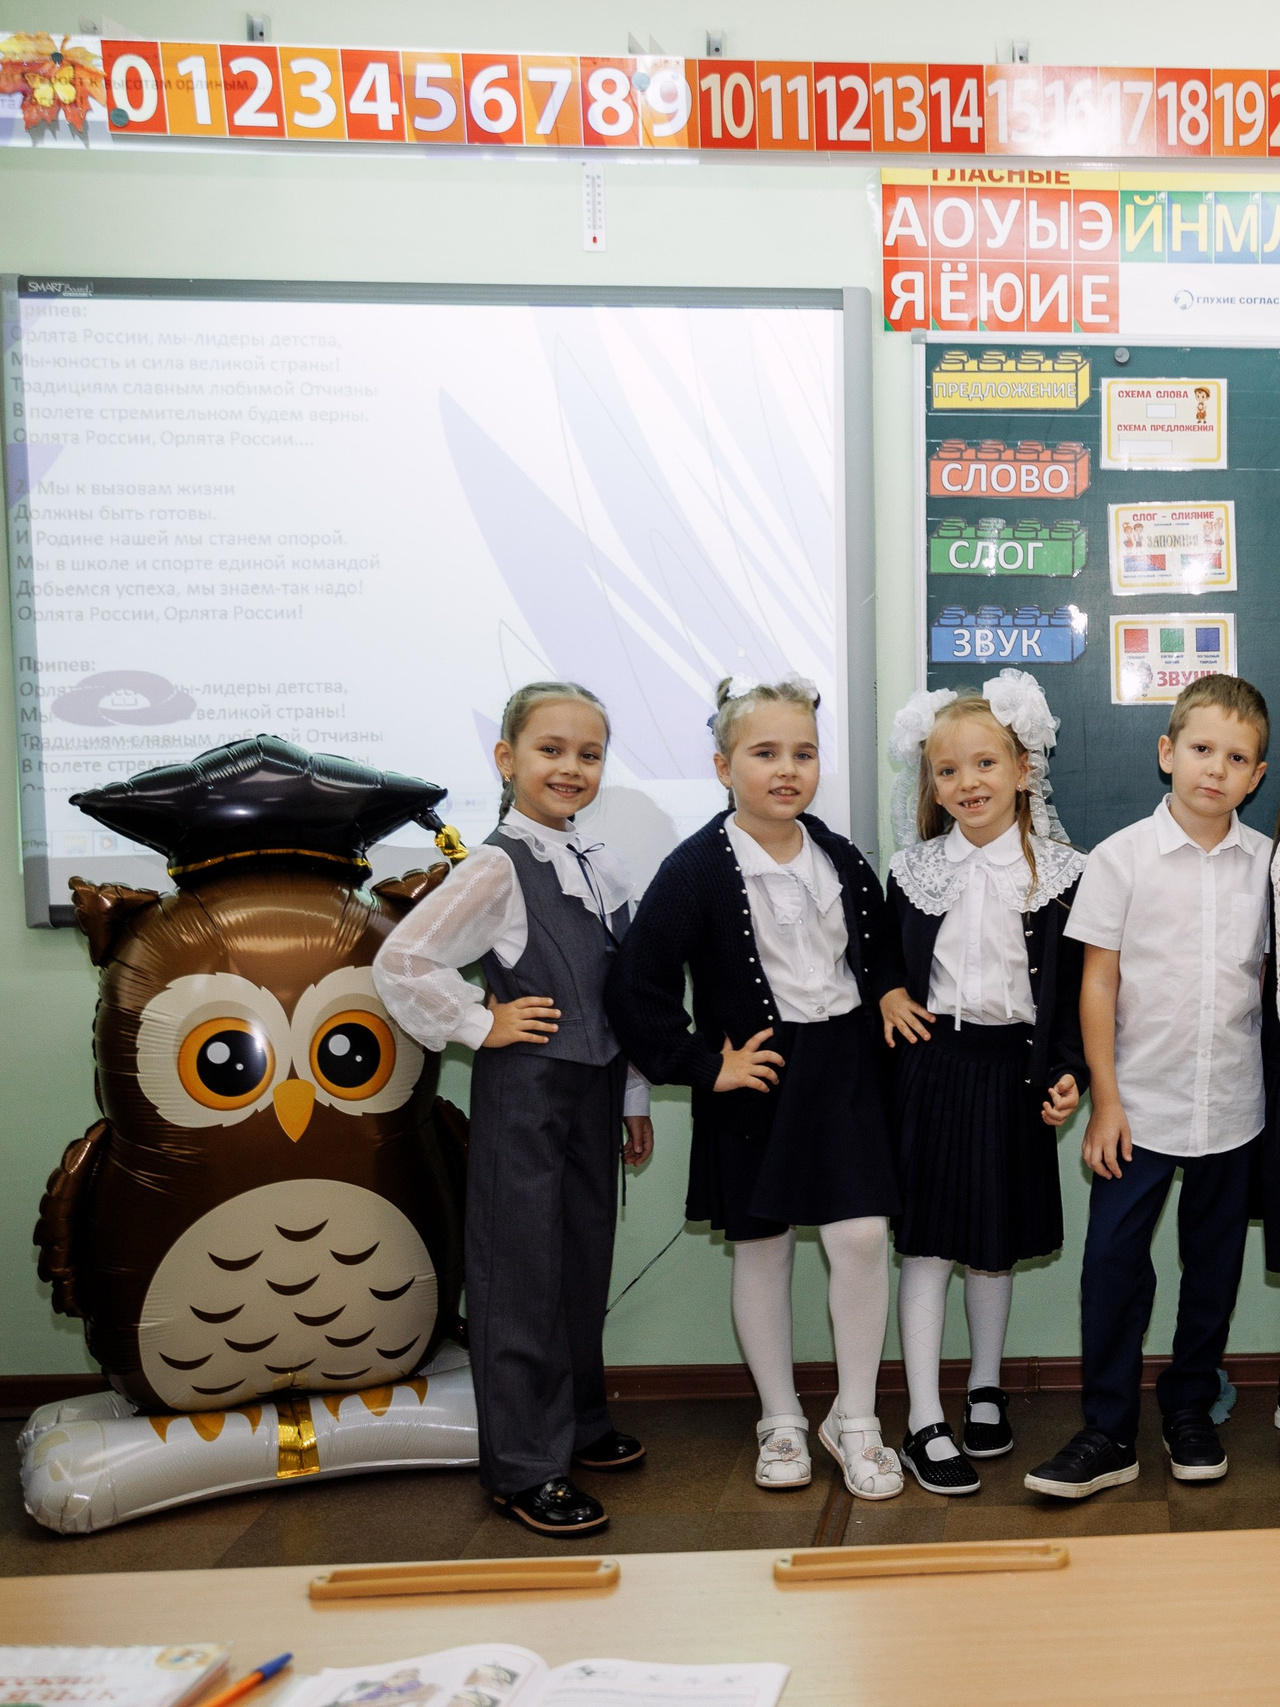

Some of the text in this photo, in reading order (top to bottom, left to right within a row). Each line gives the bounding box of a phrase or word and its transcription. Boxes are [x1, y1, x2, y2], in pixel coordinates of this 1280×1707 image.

[110, 53, 158, 122] 0
[177, 54, 212, 124] 1
[228, 57, 279, 127] 2
[292, 57, 337, 129] 3
[349, 62, 400, 130] 4
[413, 63, 457, 132] 5
[470, 64, 517, 134] 6
[526, 67, 573, 135] 7
[588, 67, 634, 136] 8
[646, 70, 692, 137] 9
[700, 72, 755, 139] 10
[759, 74, 810, 141] 11
[816, 75, 870, 141] 12
[873, 77, 926, 143] 13
[930, 78, 983, 144] 14
[987, 79, 1040, 144] 15
[1043, 79, 1097, 145] 16
[1101, 81, 1155, 145] 17
[1157, 79, 1209, 146] 18
[1214, 81, 1266, 147] 19
[28, 282, 64, 293] SMART
[11, 326, 77, 345] Орлята
[83, 328, 154, 346] России,
[12, 352, 340, 375] Мы-юность и сила великой страны!
[11, 376, 378, 397] Традициям славным любимой Отчизны
[934, 382, 1076, 401] ПРЕДЛОЖЕНИЕ
[1118, 390, 1189, 399] СХЕМА СЛОВА
[13, 402, 369, 424] В полете стремительном будем верны.
[13, 428, 80, 446] Орлята
[86, 430, 156, 446] России,
[160, 431, 225, 447] Орлята
[1117, 424, 1214, 432] СХЕМА ПРЕДЛОЖЕНИЯ
[940, 462, 1070, 494] СЛОВО
[37, 481, 69, 495] Мы
[76, 483, 86, 495] к
[91, 483, 173, 495] вызовам
[176, 484, 235, 496] жизни
[14, 504, 217, 522] Должны быть готовы.
[1132, 511, 1214, 522] СЛОГ СЛИЯНИЕ
[16, 529, 348, 548] И Родине нашей мы станем опорой.
[16, 553, 381, 574] Мы в школе и спорте единой командой
[948, 540, 1044, 570] СЛОГ
[16, 579, 364, 599] Добьемся успеха, мы знаем-так надо!
[17, 603, 303, 625] Орлята России, Орлята России!
[952, 627, 1042, 657] ЗВУК
[19, 656, 96, 675] Припев:
[275, 681, 348, 698] детства,
[196, 703, 346, 723] великой страны!
[306, 728, 384, 744] Отчизны
[22, 758, 33, 774] В
[38, 760, 103, 774] полете
